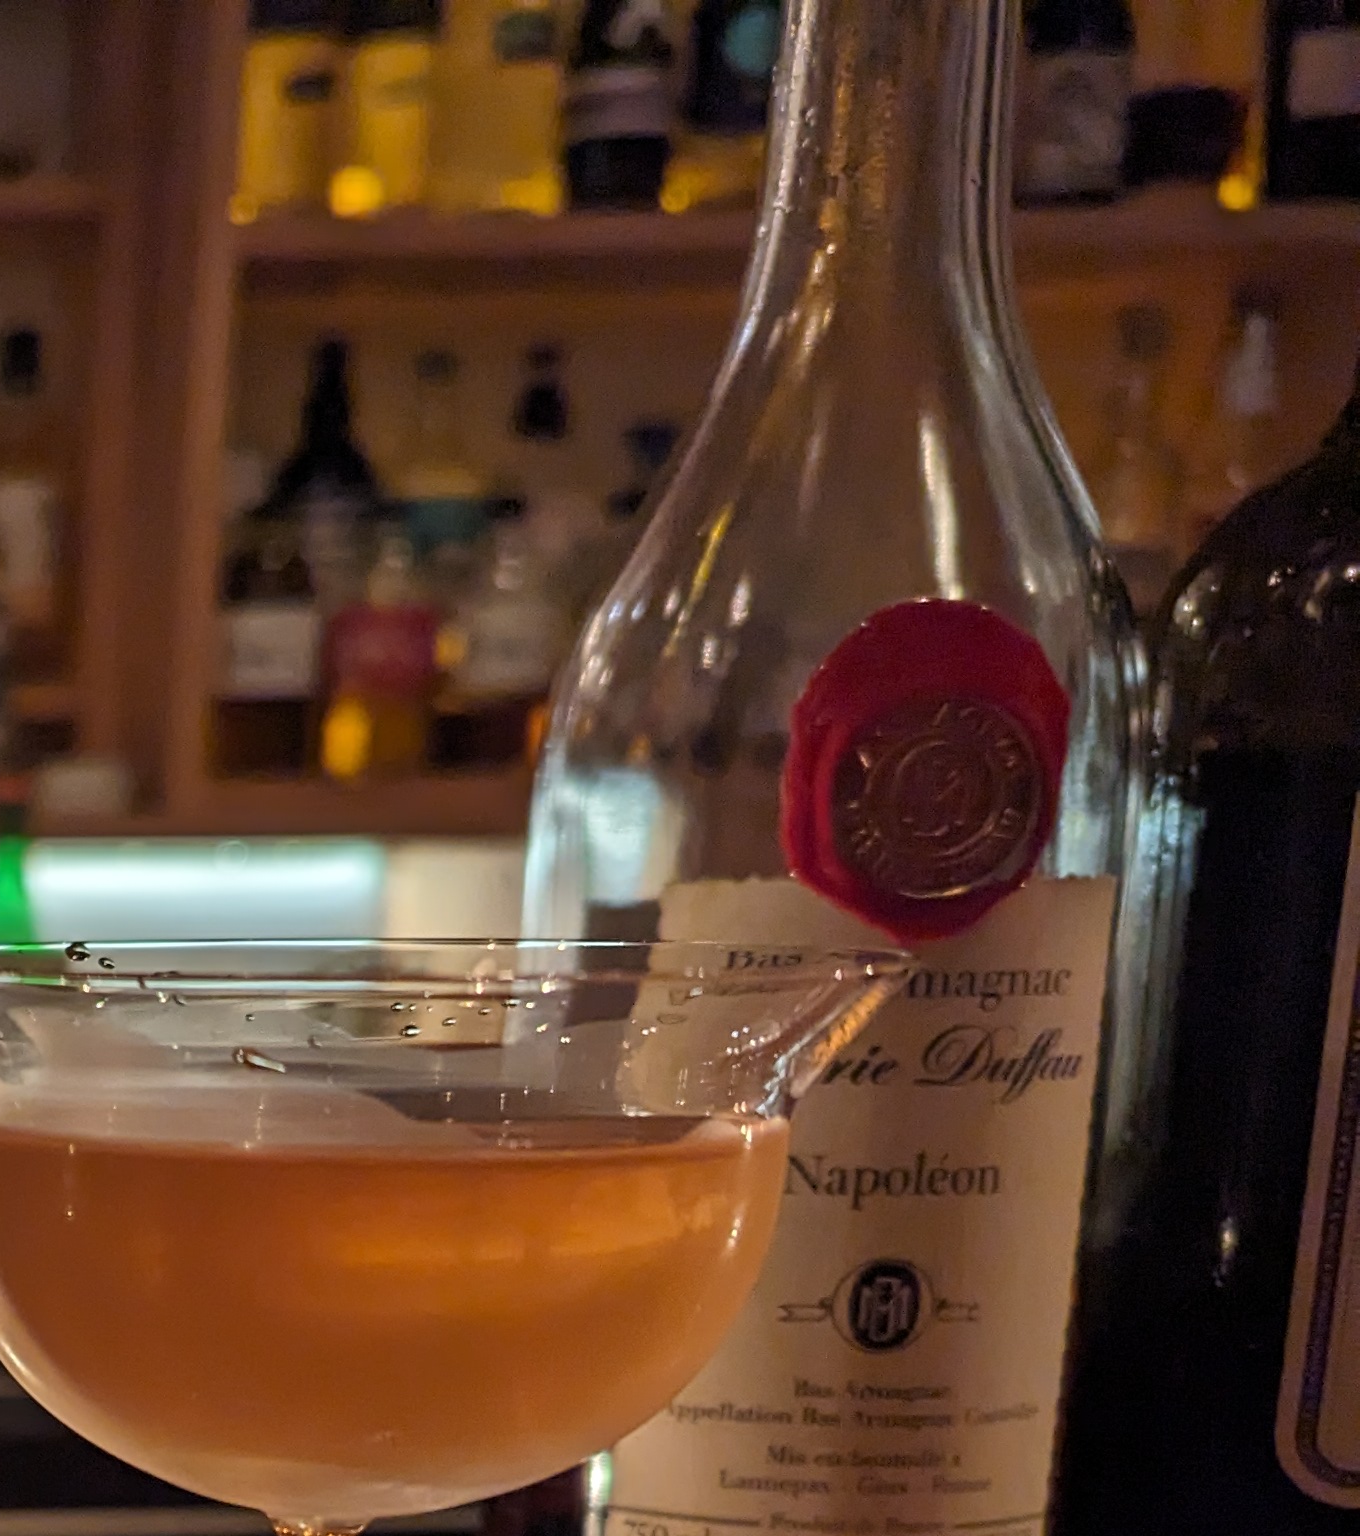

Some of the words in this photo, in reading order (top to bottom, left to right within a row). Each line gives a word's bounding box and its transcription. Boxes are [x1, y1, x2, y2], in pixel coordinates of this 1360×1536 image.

[903, 965, 1072, 1011] magnac
[821, 1046, 899, 1086] rie
[915, 1022, 1084, 1108] Duffau
[784, 1151, 1002, 1211] Napoléon
